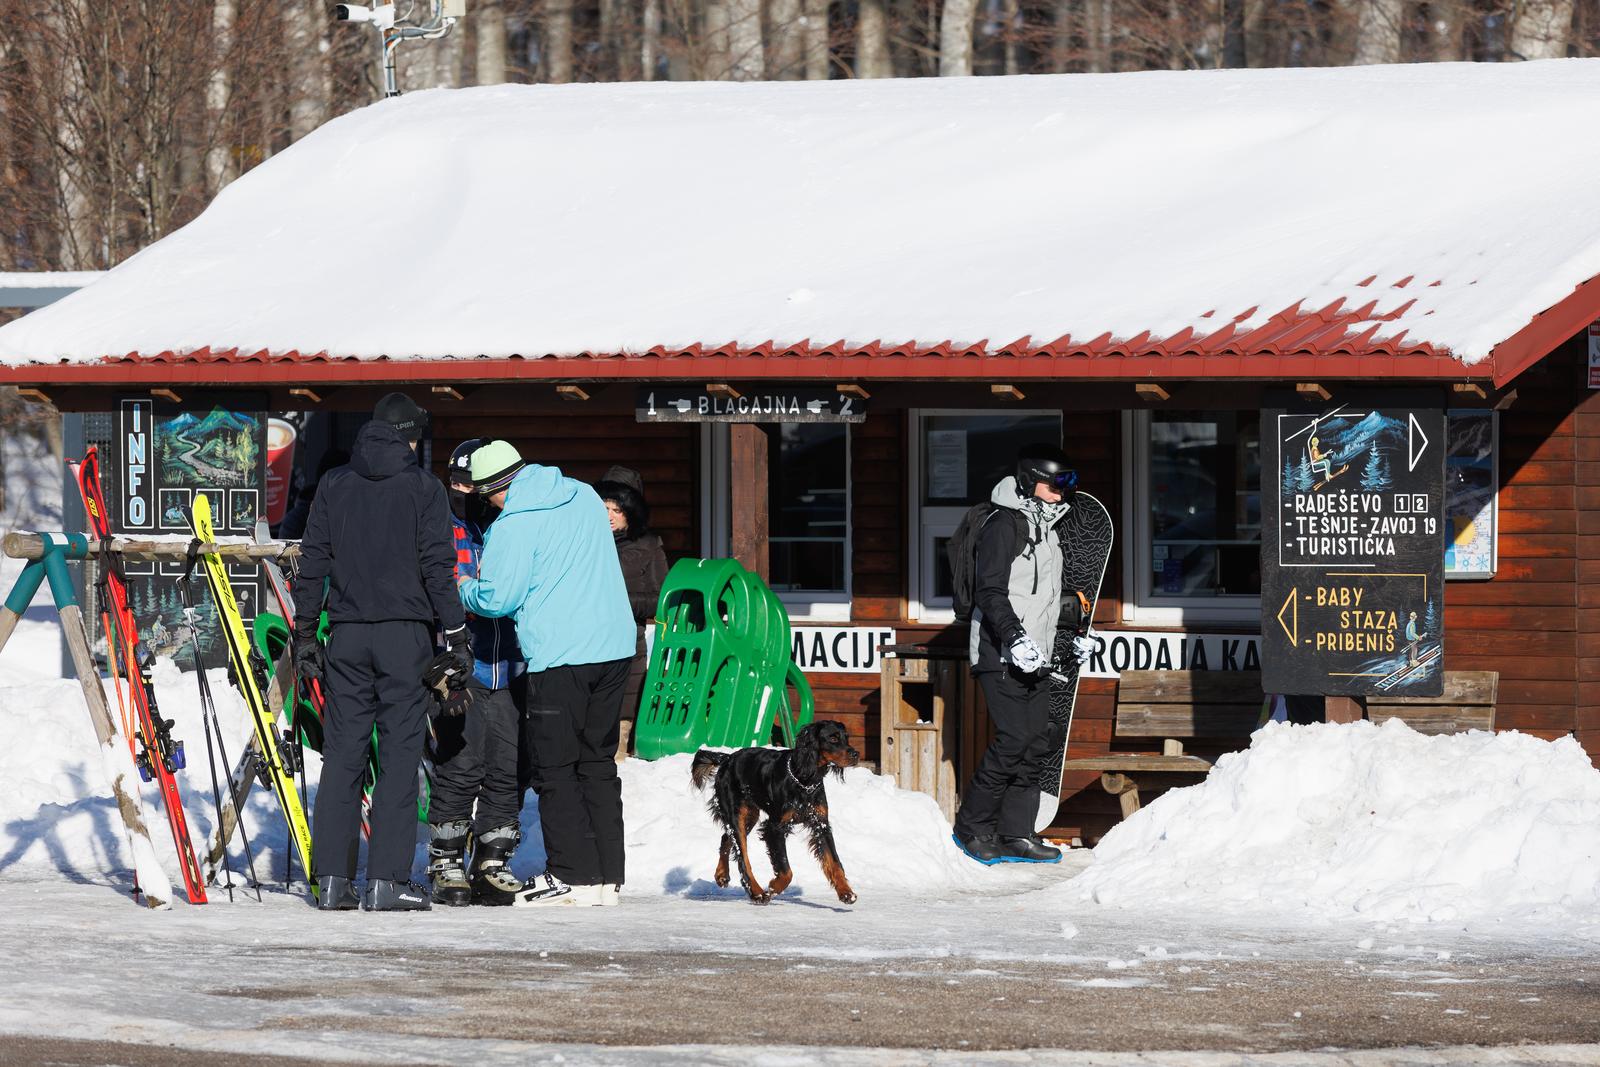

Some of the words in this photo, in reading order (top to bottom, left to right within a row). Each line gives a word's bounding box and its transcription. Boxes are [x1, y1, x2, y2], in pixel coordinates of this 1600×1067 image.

[648, 392, 657, 415] 1
[839, 394, 853, 416] 2
[128, 403, 146, 526] INFO
[1398, 497, 1405, 510] 1
[1416, 497, 1424, 511] 2
[1423, 517, 1437, 535] 19
[1340, 610, 1398, 630] STAZA
